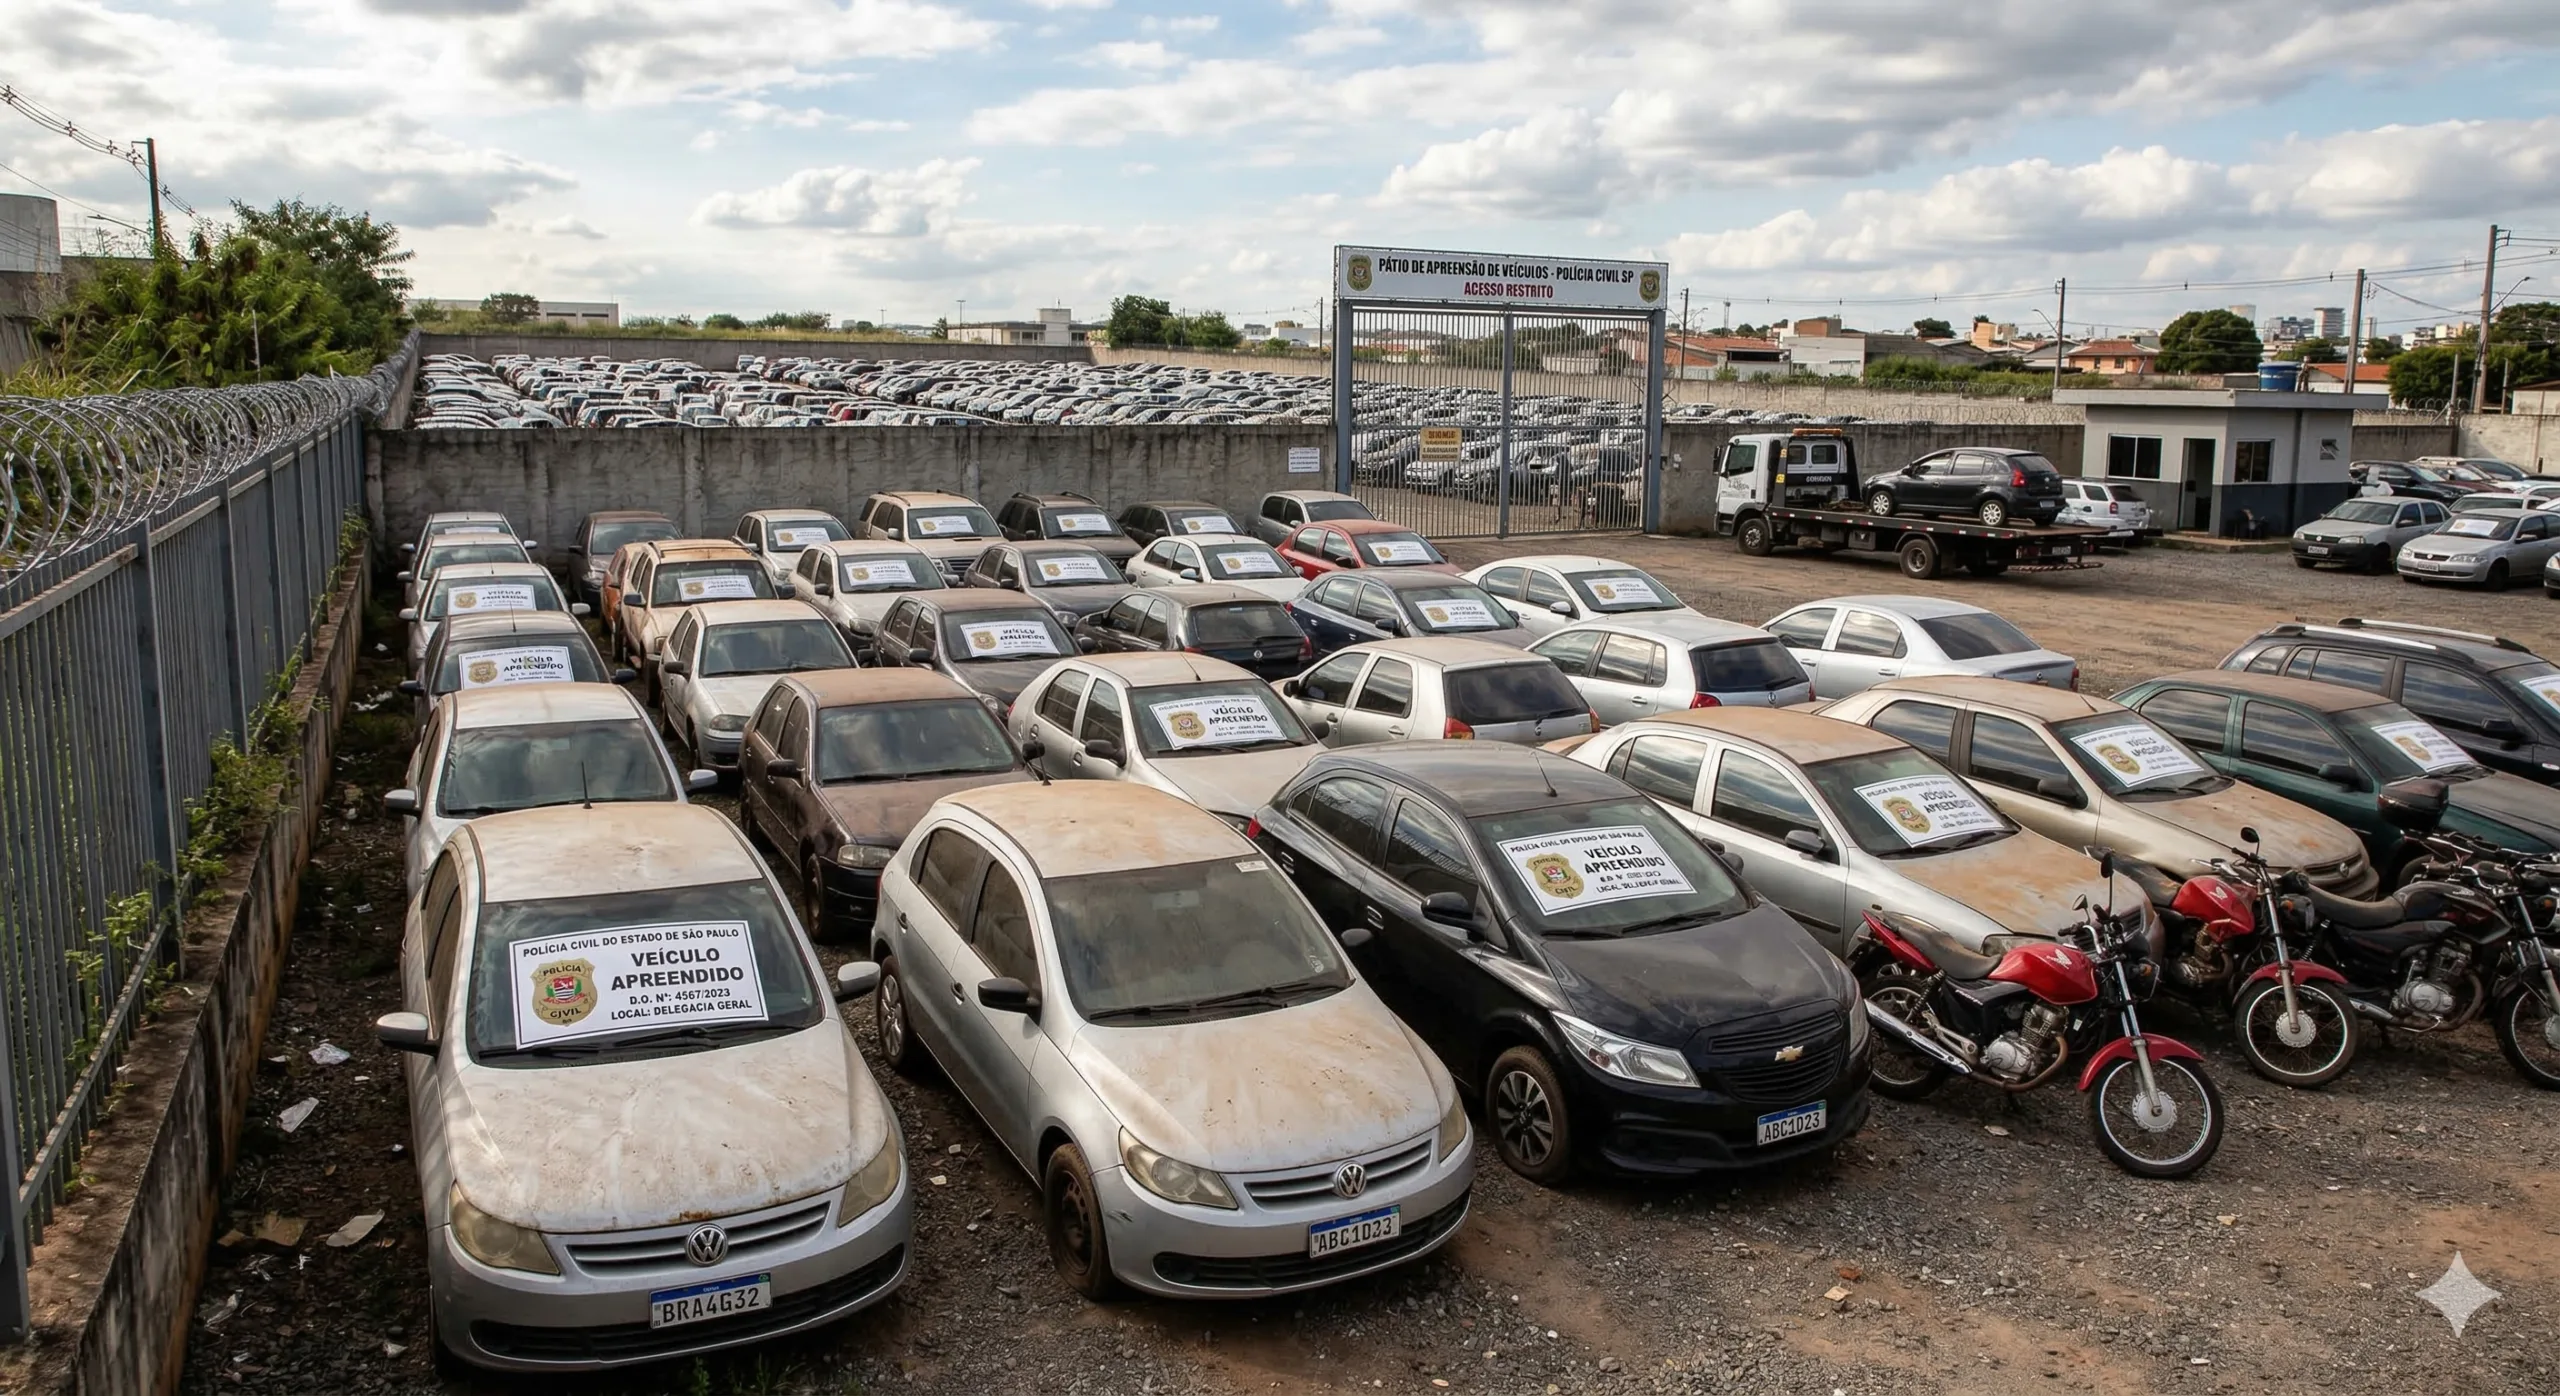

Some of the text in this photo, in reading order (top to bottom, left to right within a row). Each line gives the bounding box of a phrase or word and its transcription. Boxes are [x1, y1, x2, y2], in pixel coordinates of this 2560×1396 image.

[1379, 256, 1409, 273] PÁTIO
[1412, 260, 1425, 274] DE
[1426, 260, 1485, 276] APREENSÃO
[1488, 263, 1500, 277] DE
[1502, 262, 1549, 279] VEÍCULOS
[1556, 265, 1594, 282] POLÍCIA
[1595, 269, 1620, 283] CIVIL
[1621, 270, 1634, 284] SP
[1464, 282, 1554, 299] ACESSO RESTRITO
[523, 928, 739, 957] POLÍCIA CIVIL DO ESTADO DE SÃO PAULO
[631, 947, 720, 967] VEÍCULO
[611, 966, 744, 991] APREENDIDO
[629, 994, 653, 1005] D.O.
[675, 988, 731, 1001] 4567/2023
[611, 999, 752, 1020] LOCAL: DELEGACIA GERAL
[663, 1287, 759, 1324] BRA4G32
